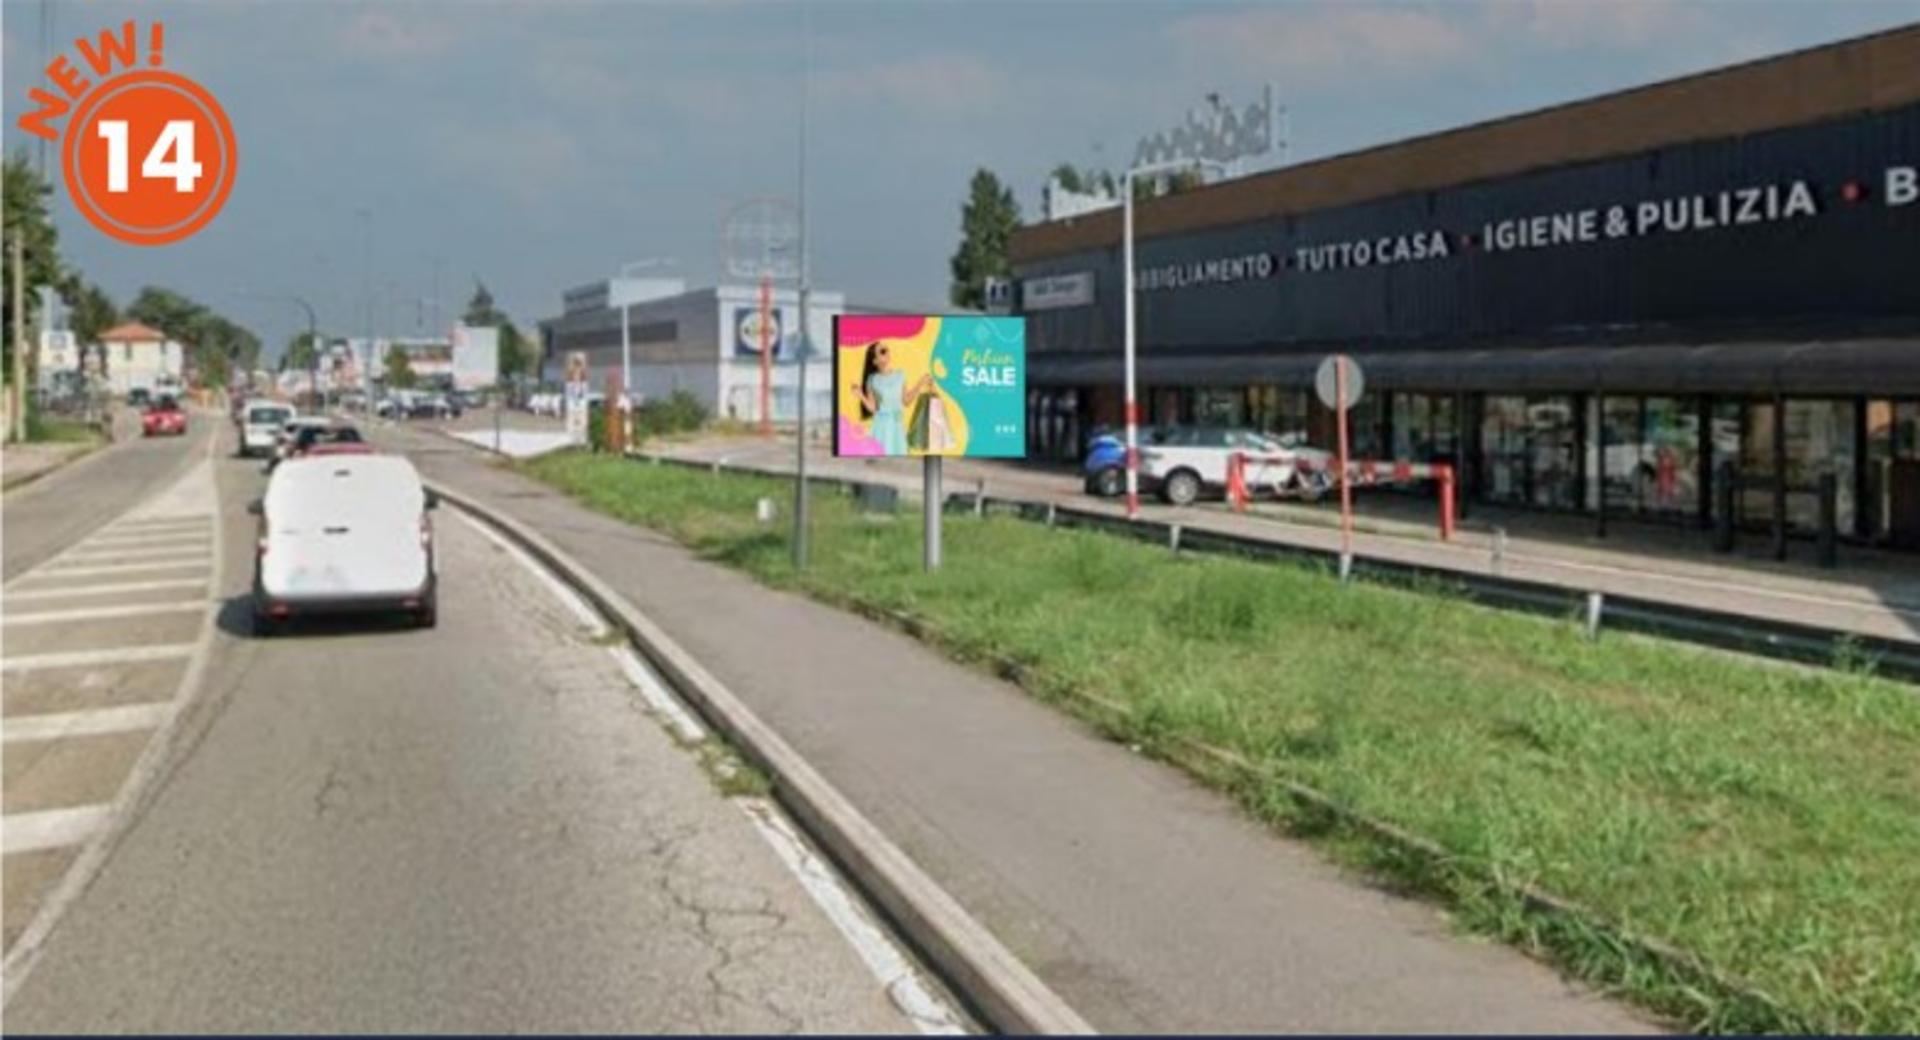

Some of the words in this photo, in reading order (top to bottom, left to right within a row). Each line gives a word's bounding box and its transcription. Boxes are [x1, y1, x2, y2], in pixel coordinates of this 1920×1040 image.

[1135, 252, 1272, 291] BBIGLIAMENTO
[1296, 240, 1371, 272] TUTTO
[1376, 229, 1449, 264] CASA
[1484, 209, 1598, 250] IGIENE
[1604, 205, 1629, 238] &
[1636, 181, 1816, 236] PULIZIA
[961, 366, 1016, 387] SALE
